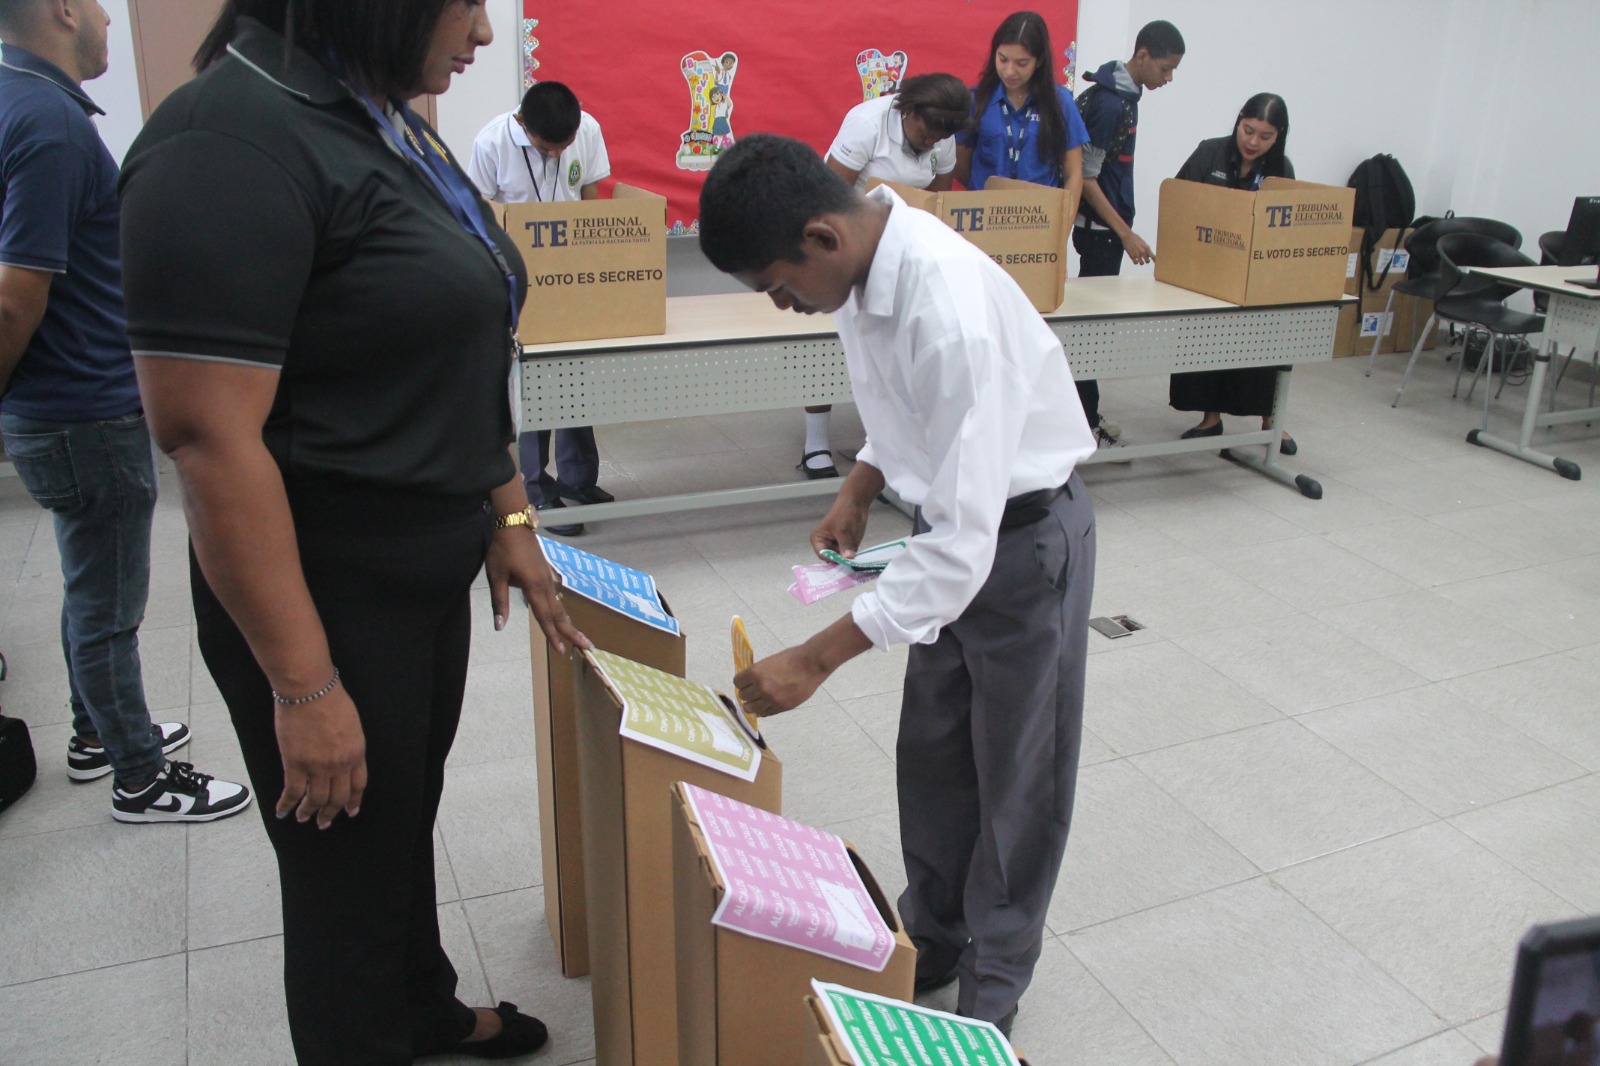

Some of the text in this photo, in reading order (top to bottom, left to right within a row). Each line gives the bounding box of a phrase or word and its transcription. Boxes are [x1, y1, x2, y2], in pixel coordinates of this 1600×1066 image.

[989, 205, 1044, 215] TRIBUNAL
[1296, 203, 1340, 212] TRIBUNAL
[573, 216, 642, 228] TRIBUNAL
[951, 207, 984, 232] TE
[988, 215, 1050, 225] ELECTORAL
[1265, 205, 1293, 228] TE
[1294, 212, 1344, 221] ELECTORAL
[525, 220, 568, 248] TE
[573, 227, 651, 238] ELECTORAL
[1196, 225, 1213, 244] TE
[1005, 252, 1058, 265] SECRETO
[1253, 246, 1348, 260] EL VOTO ES SECRETO
[536, 273, 574, 287] VOTO
[577, 272, 595, 285] ES
[599, 269, 663, 283] SECRETO
